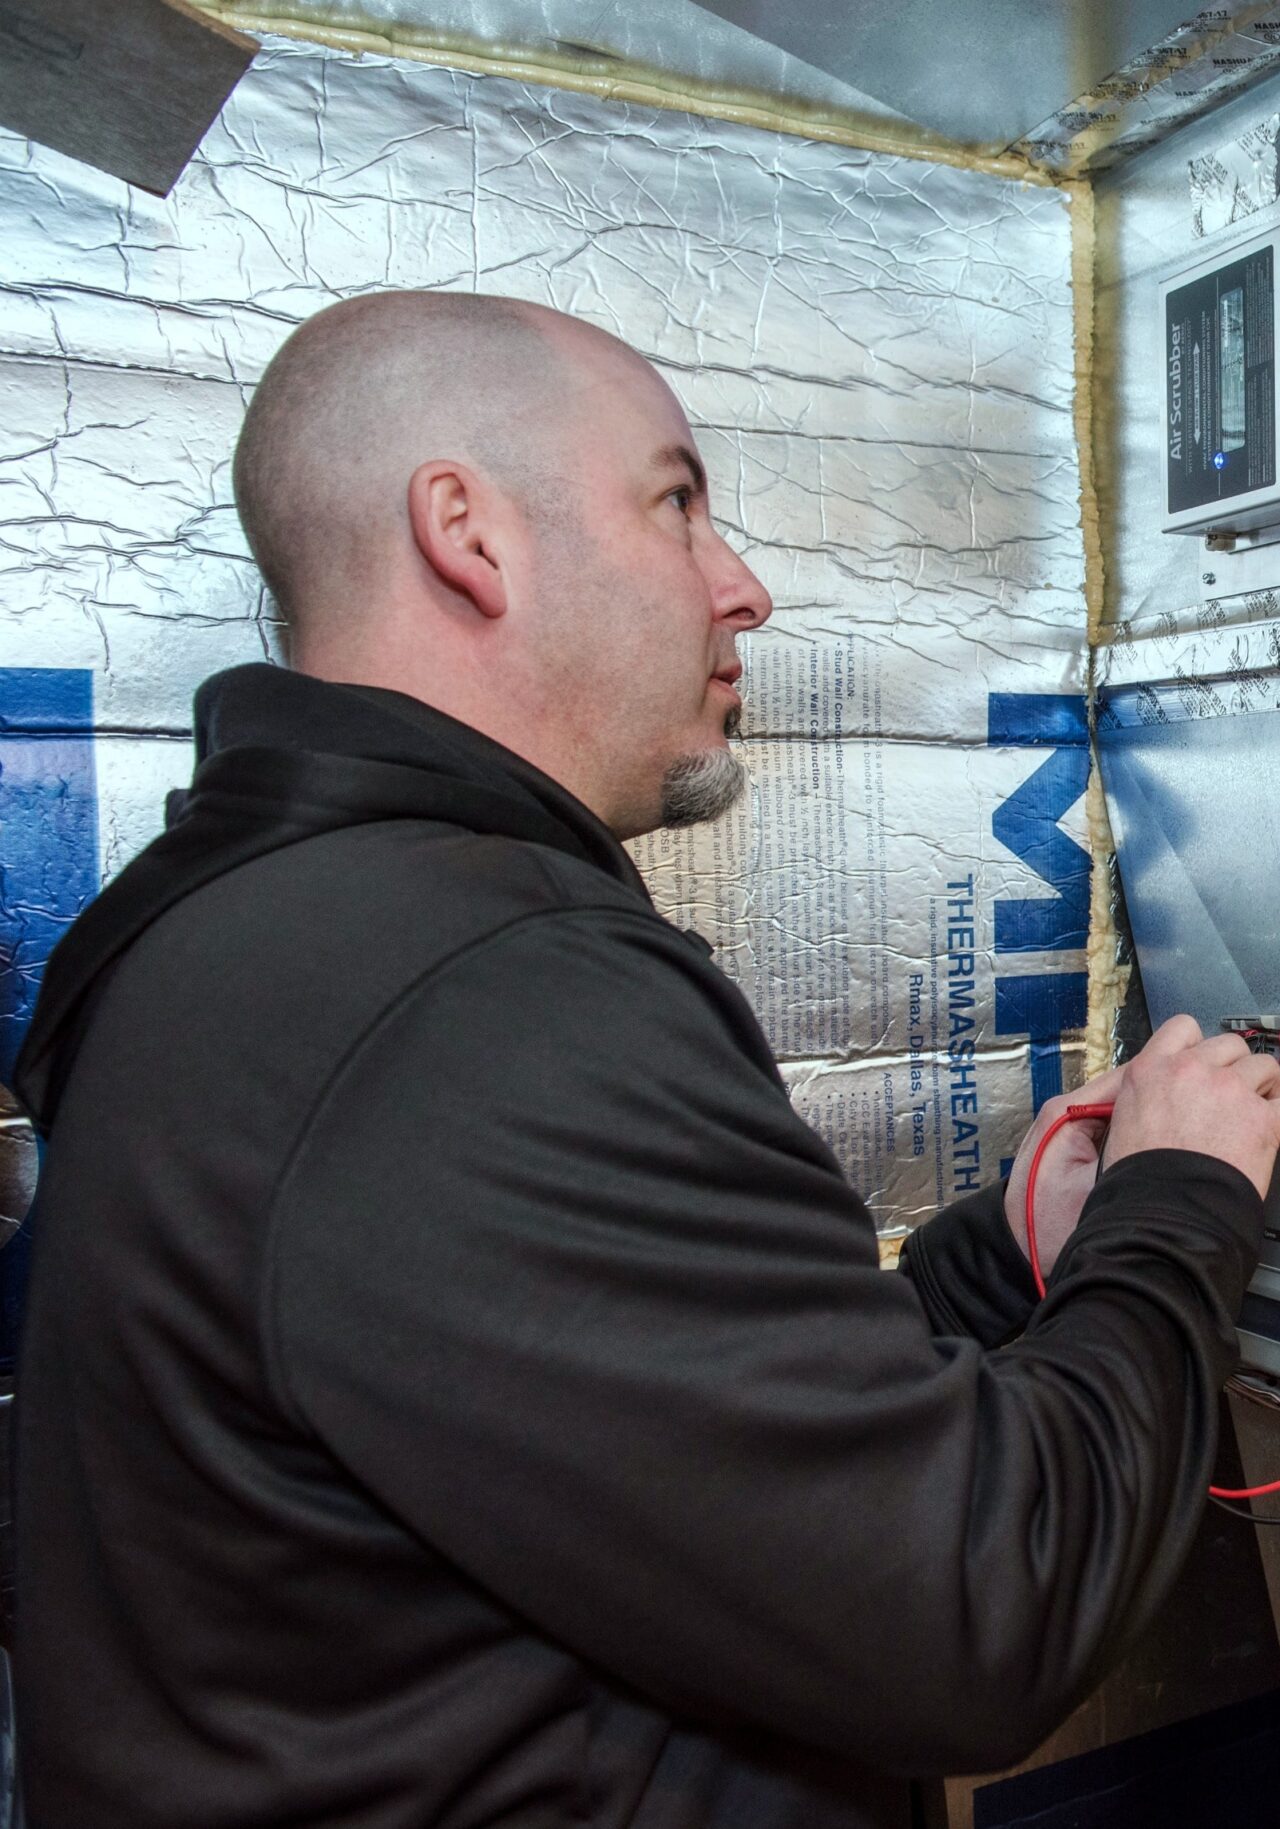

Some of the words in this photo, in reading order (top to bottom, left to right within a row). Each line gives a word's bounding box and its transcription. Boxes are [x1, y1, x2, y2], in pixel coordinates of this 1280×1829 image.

[1168, 322, 1182, 426] Scrubber
[1169, 428, 1182, 461] Air
[760, 648, 770, 689] Thermal
[772, 648, 781, 669] wall
[809, 648, 819, 690] Interior
[822, 648, 831, 672] walls
[834, 650, 844, 674] Stud
[773, 672, 782, 694] with
[783, 648, 795, 708] application,
[798, 662, 807, 684] stud
[823, 674, 831, 692] and
[799, 688, 808, 714] walls
[834, 677, 844, 700] Wall
[761, 692, 771, 728] barrier
[810, 692, 820, 716] Wall
[823, 694, 832, 732] covered
[774, 706, 783, 729] inch
[763, 758, 772, 771] be
[865, 752, 874, 790] bonded
[825, 764, 834, 800] suitable
[875, 772, 885, 794] rigid
[763, 774, 773, 817] installed
[775, 775, 785, 826] wallboard
[788, 804, 798, 828] must
[826, 802, 834, 838] exterior
[738, 814, 749, 856] building
[789, 832, 798, 844] be
[713, 841, 722, 860] and
[826, 840, 835, 865] finish
[674, 874, 684, 899] when
[815, 916, 824, 928] be
[780, 998, 789, 1015] fire
[907, 974, 924, 1032] Rmax,
[781, 1018, 790, 1054] barrier
[946, 872, 980, 1192] THERMASHEATH
[908, 1036, 926, 1098] Dallas,
[862, 1100, 871, 1118] ICC
[931, 1088, 942, 1135] sheathing
[912, 1104, 928, 1156] Texas
